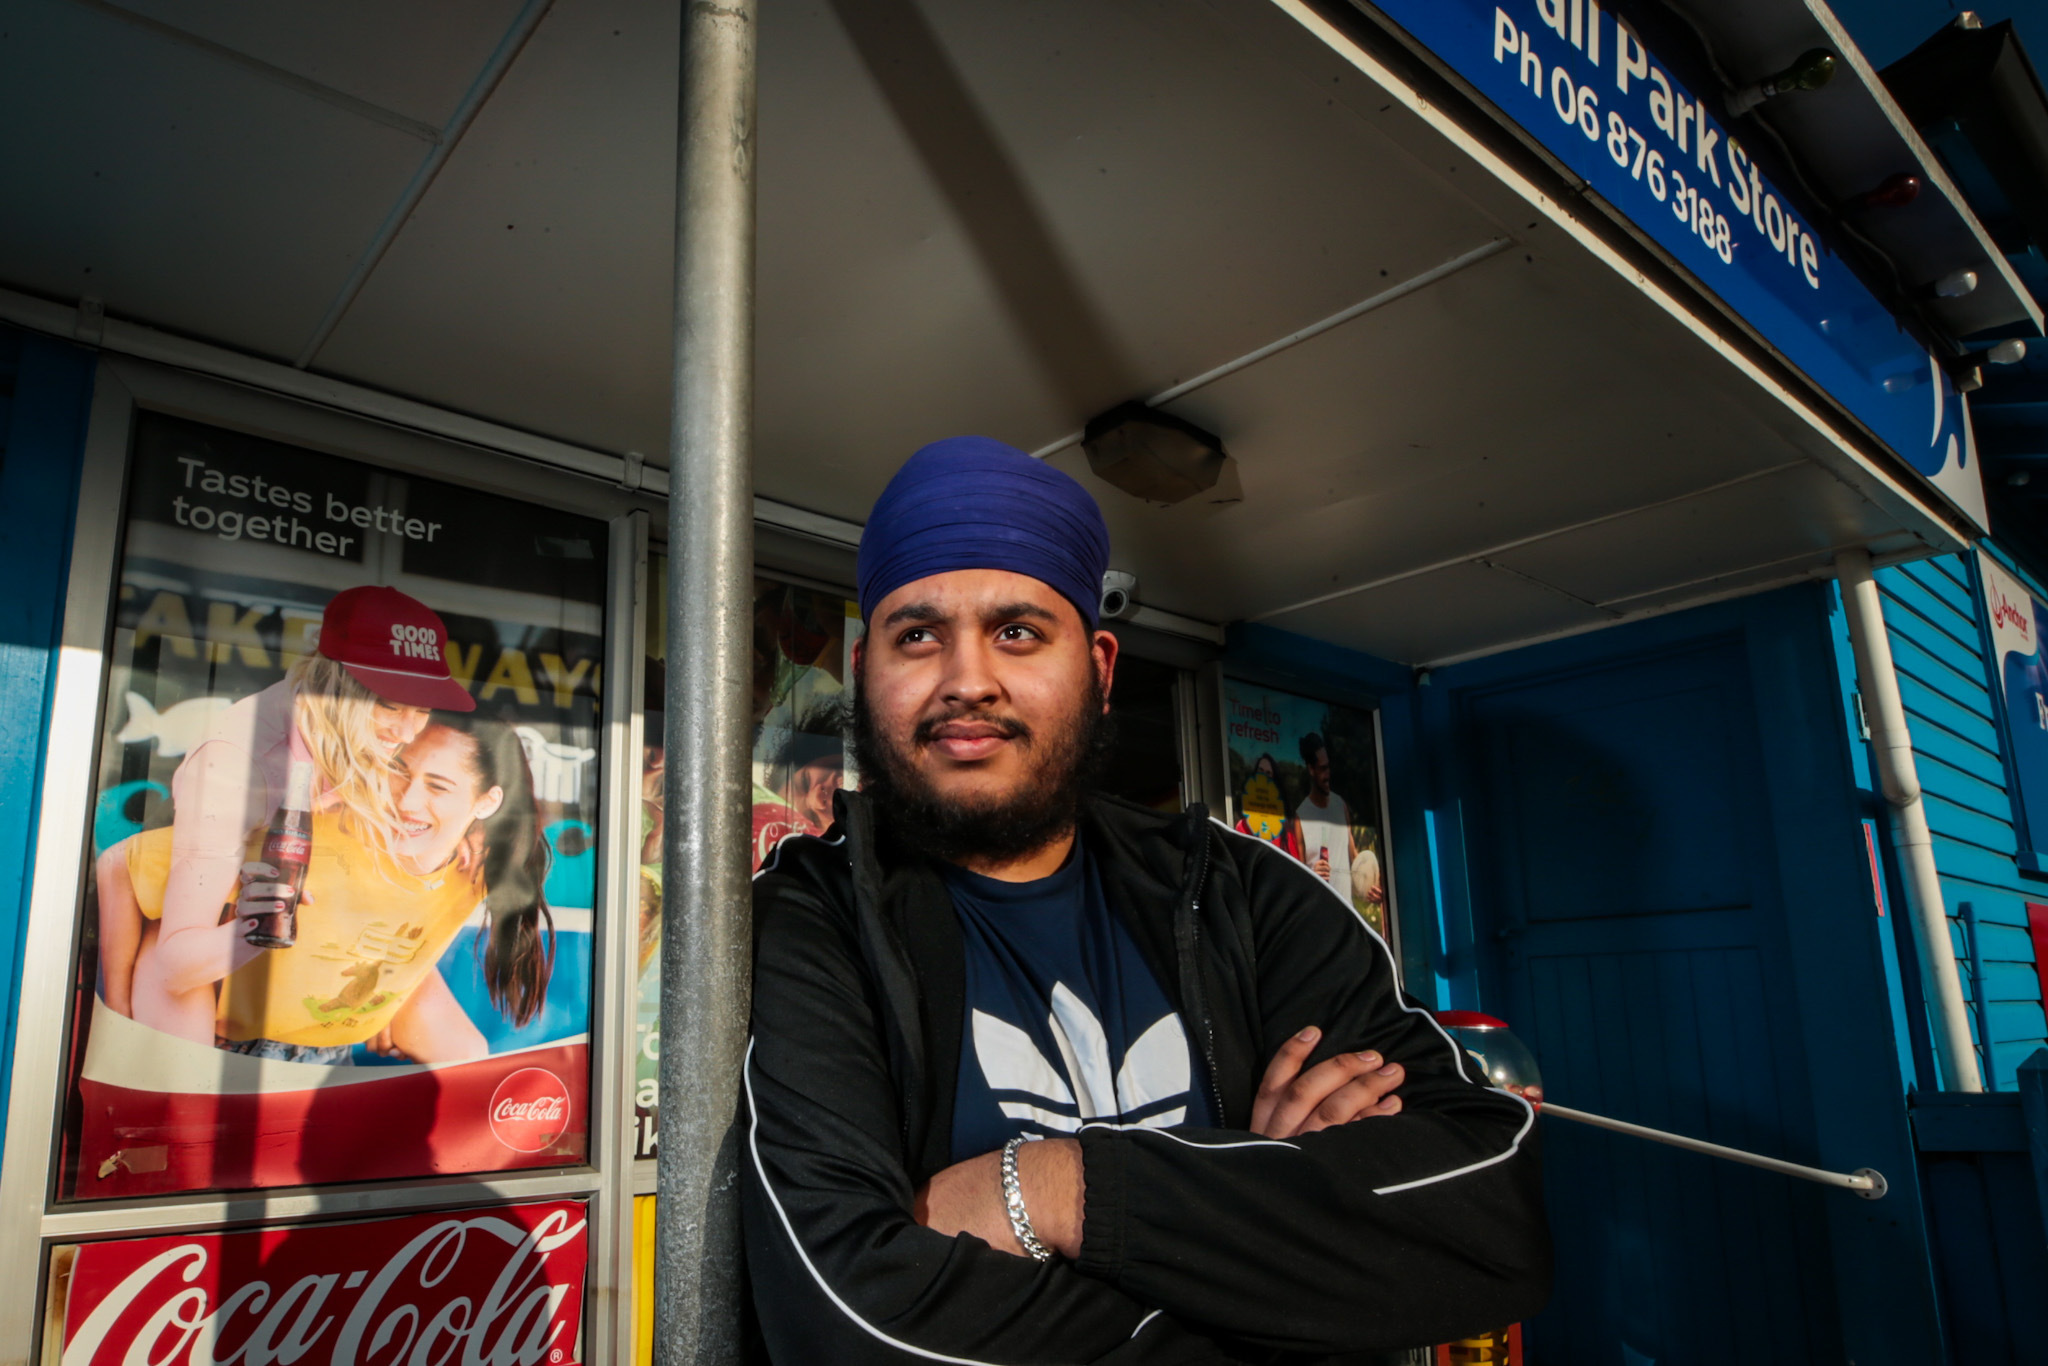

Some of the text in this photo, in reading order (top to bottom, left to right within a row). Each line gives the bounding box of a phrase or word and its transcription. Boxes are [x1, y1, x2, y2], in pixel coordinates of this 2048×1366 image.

[1494, 6, 1732, 264] Ph 06 876 3188
[1617, 12, 1721, 189] Park
[1727, 136, 1819, 289] Store
[178, 456, 441, 542] Tastes better
[173, 496, 354, 557] together
[2003, 593, 2028, 634] Anchor
[389, 640, 440, 661] TIMES
[391, 624, 437, 645] GOOD
[1229, 697, 1263, 722] Time
[1229, 722, 1280, 744] refresh
[493, 1096, 566, 1123] Coca-Cola
[62, 1209, 587, 1366] Coca-Cola
